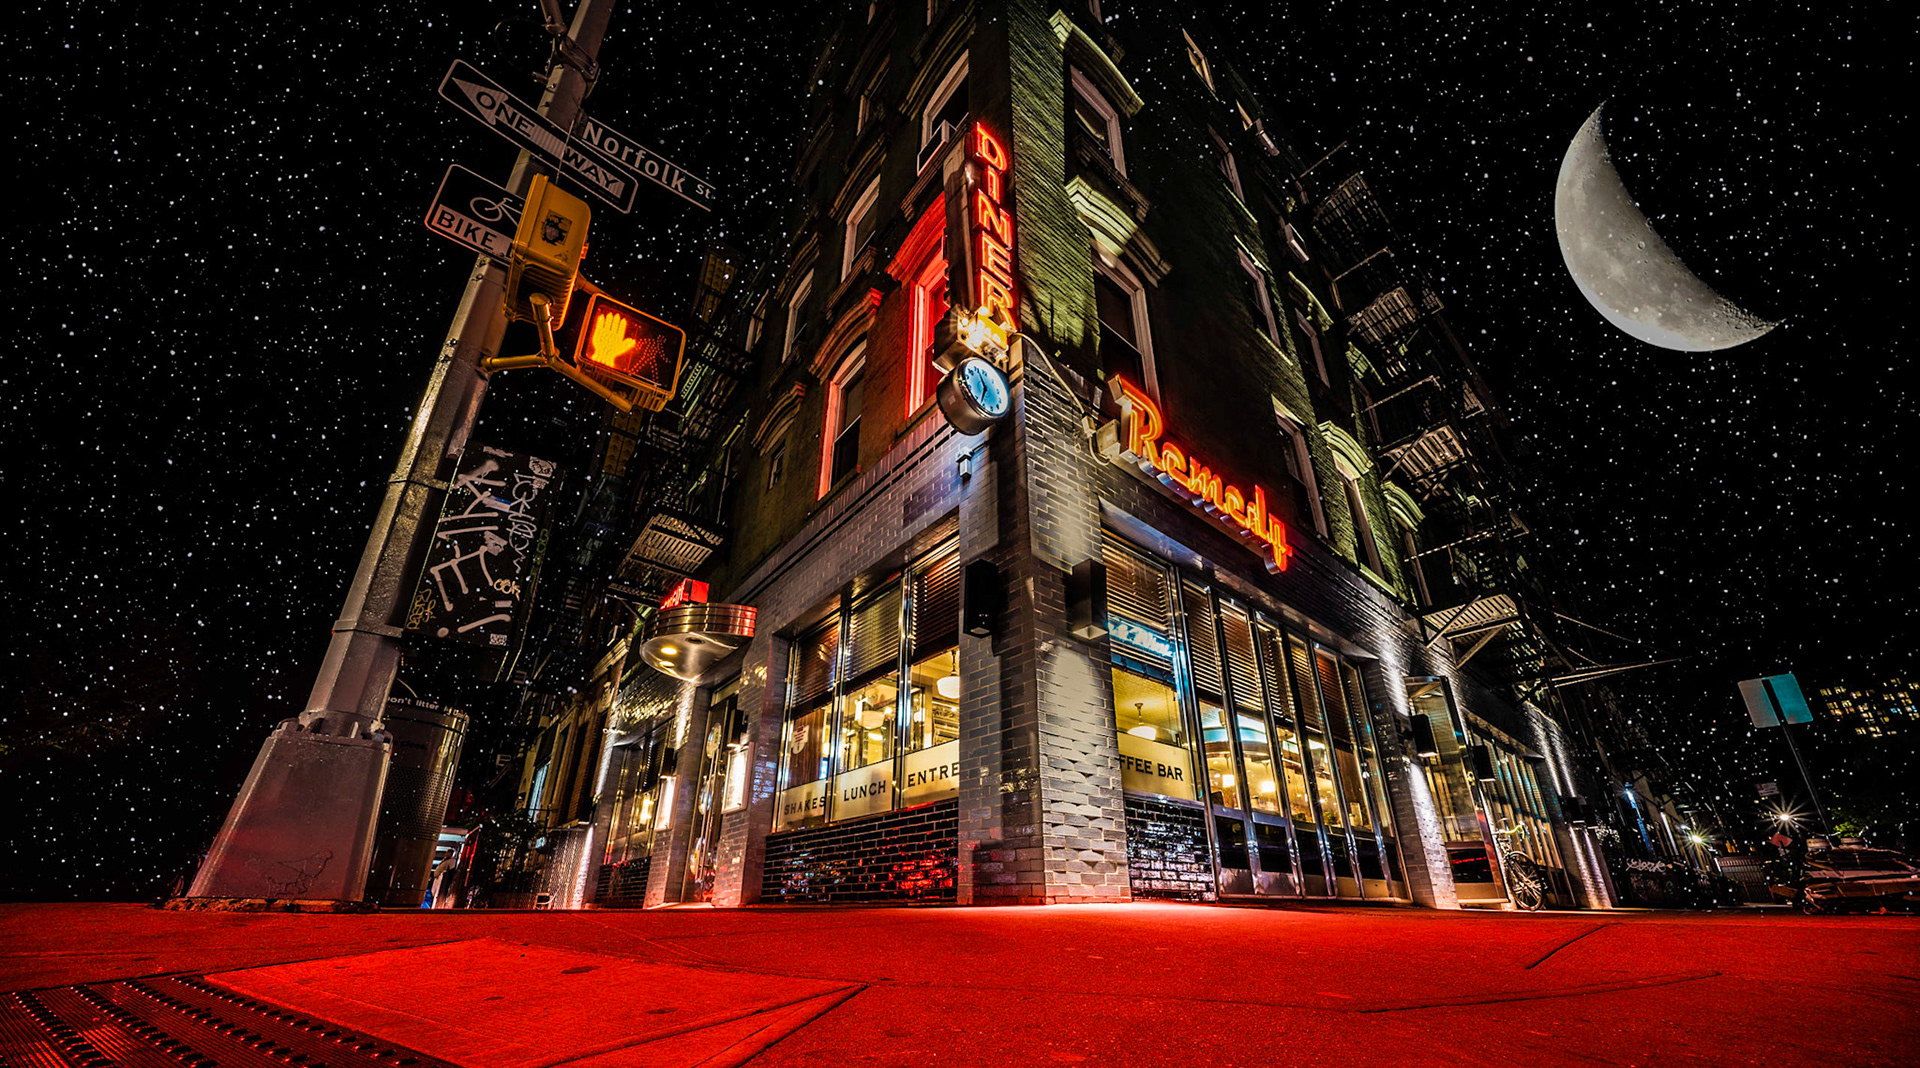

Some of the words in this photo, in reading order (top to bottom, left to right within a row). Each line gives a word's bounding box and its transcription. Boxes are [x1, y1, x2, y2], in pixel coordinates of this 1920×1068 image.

[475, 91, 535, 138] ONE
[564, 145, 619, 189] WAY
[582, 121, 686, 193] Norfolk
[436, 209, 497, 251] BIKE
[975, 121, 1018, 333] DINER
[1116, 373, 1293, 572] Remedy
[386, 696, 412, 706] on't
[907, 762, 960, 788] ENTRE
[1157, 762, 1184, 782] BAR
[783, 795, 826, 816] SHAKES
[843, 780, 887, 802] LUNCH
